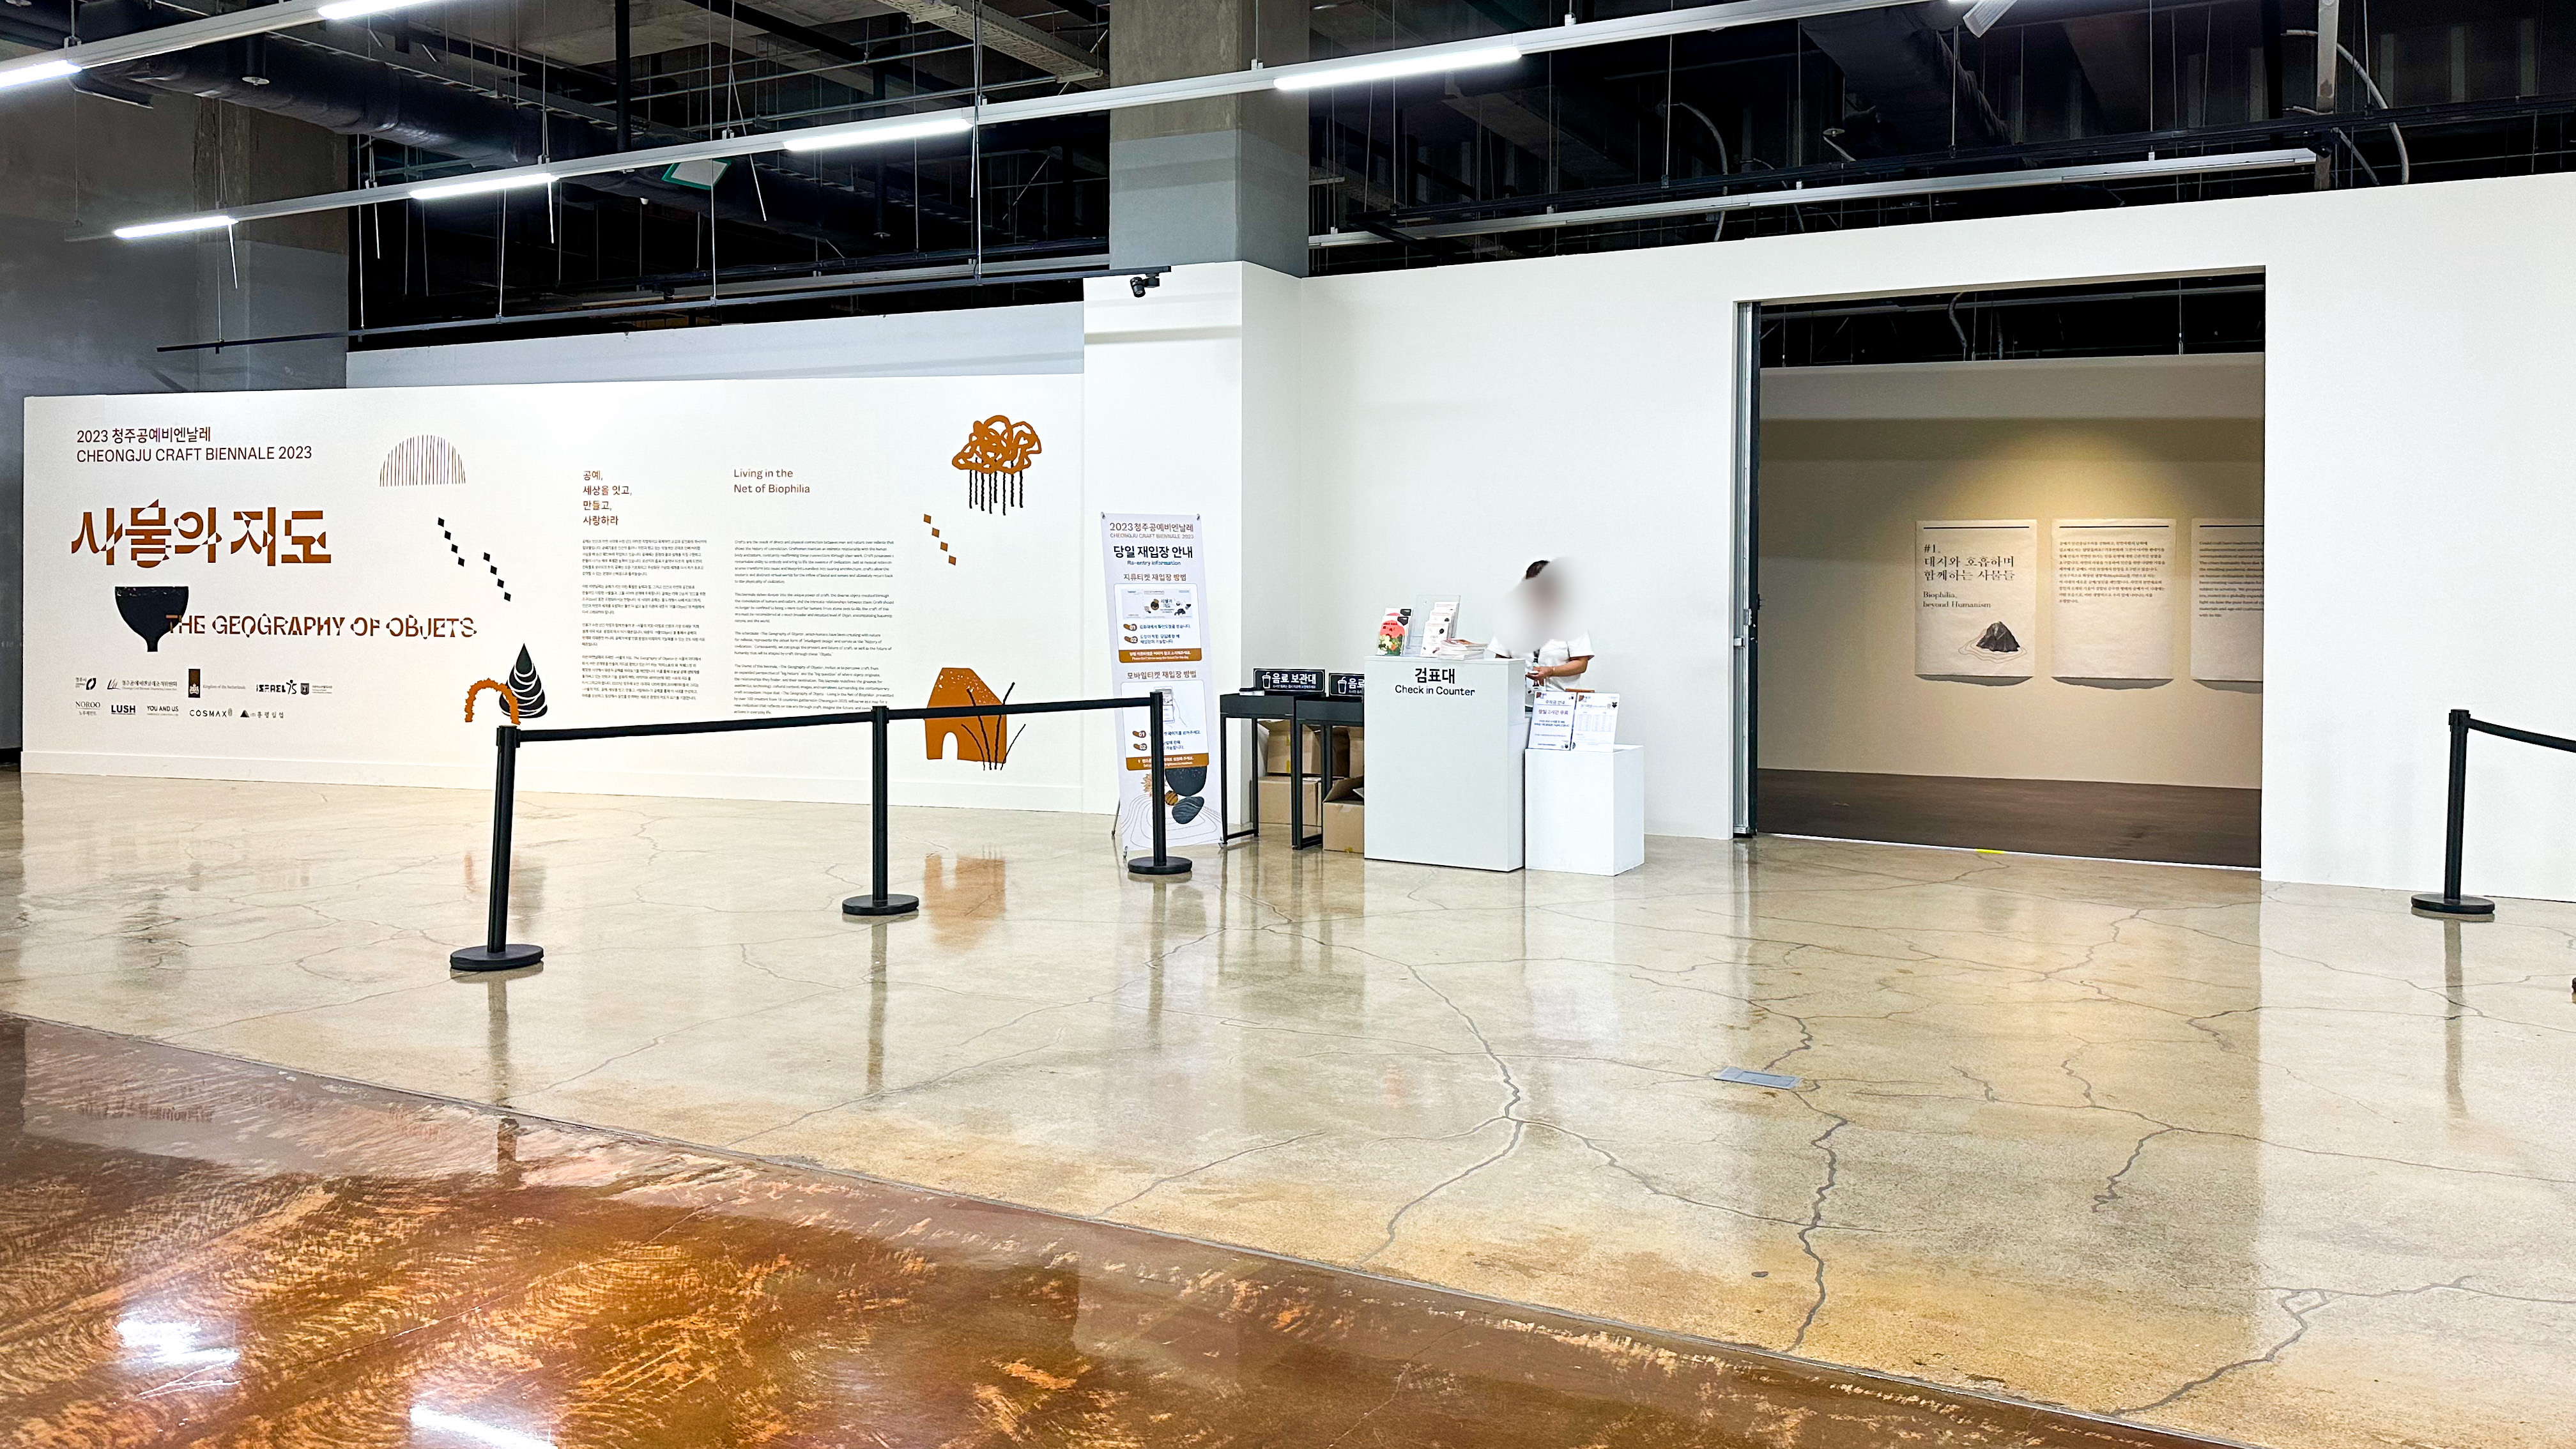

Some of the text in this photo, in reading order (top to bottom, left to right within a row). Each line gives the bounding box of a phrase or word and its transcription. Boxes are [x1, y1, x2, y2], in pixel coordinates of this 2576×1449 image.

[77, 427, 210, 443] 2023 청주공예비엔날레
[77, 446, 311, 462] CHEONGJU CRAFT BIENNALE 2023
[583, 471, 602, 480] 공예,
[734, 468, 793, 479] Living in the
[583, 486, 631, 495] 세상을 잇고,
[734, 484, 809, 494] Net of Biophilia
[583, 501, 611, 510] 만들고,
[583, 516, 618, 526] 사랑하라
[72, 499, 331, 568] 사물의 지도
[1114, 546, 1193, 558] 당일 재입장 안내
[1924, 556, 1961, 567] 대지와
[1924, 570, 2015, 581] 함께하는 사물들
[1923, 591, 1957, 600] Biophilia,
[165, 613, 477, 640] THE GEOGRAPHY OF OBJETS
[1272, 673, 1316, 684] 음료 보관대
[1415, 668, 1455, 684] 검표대
[1395, 685, 1475, 696] Check in Counter
[111, 705, 135, 713] LUSH
